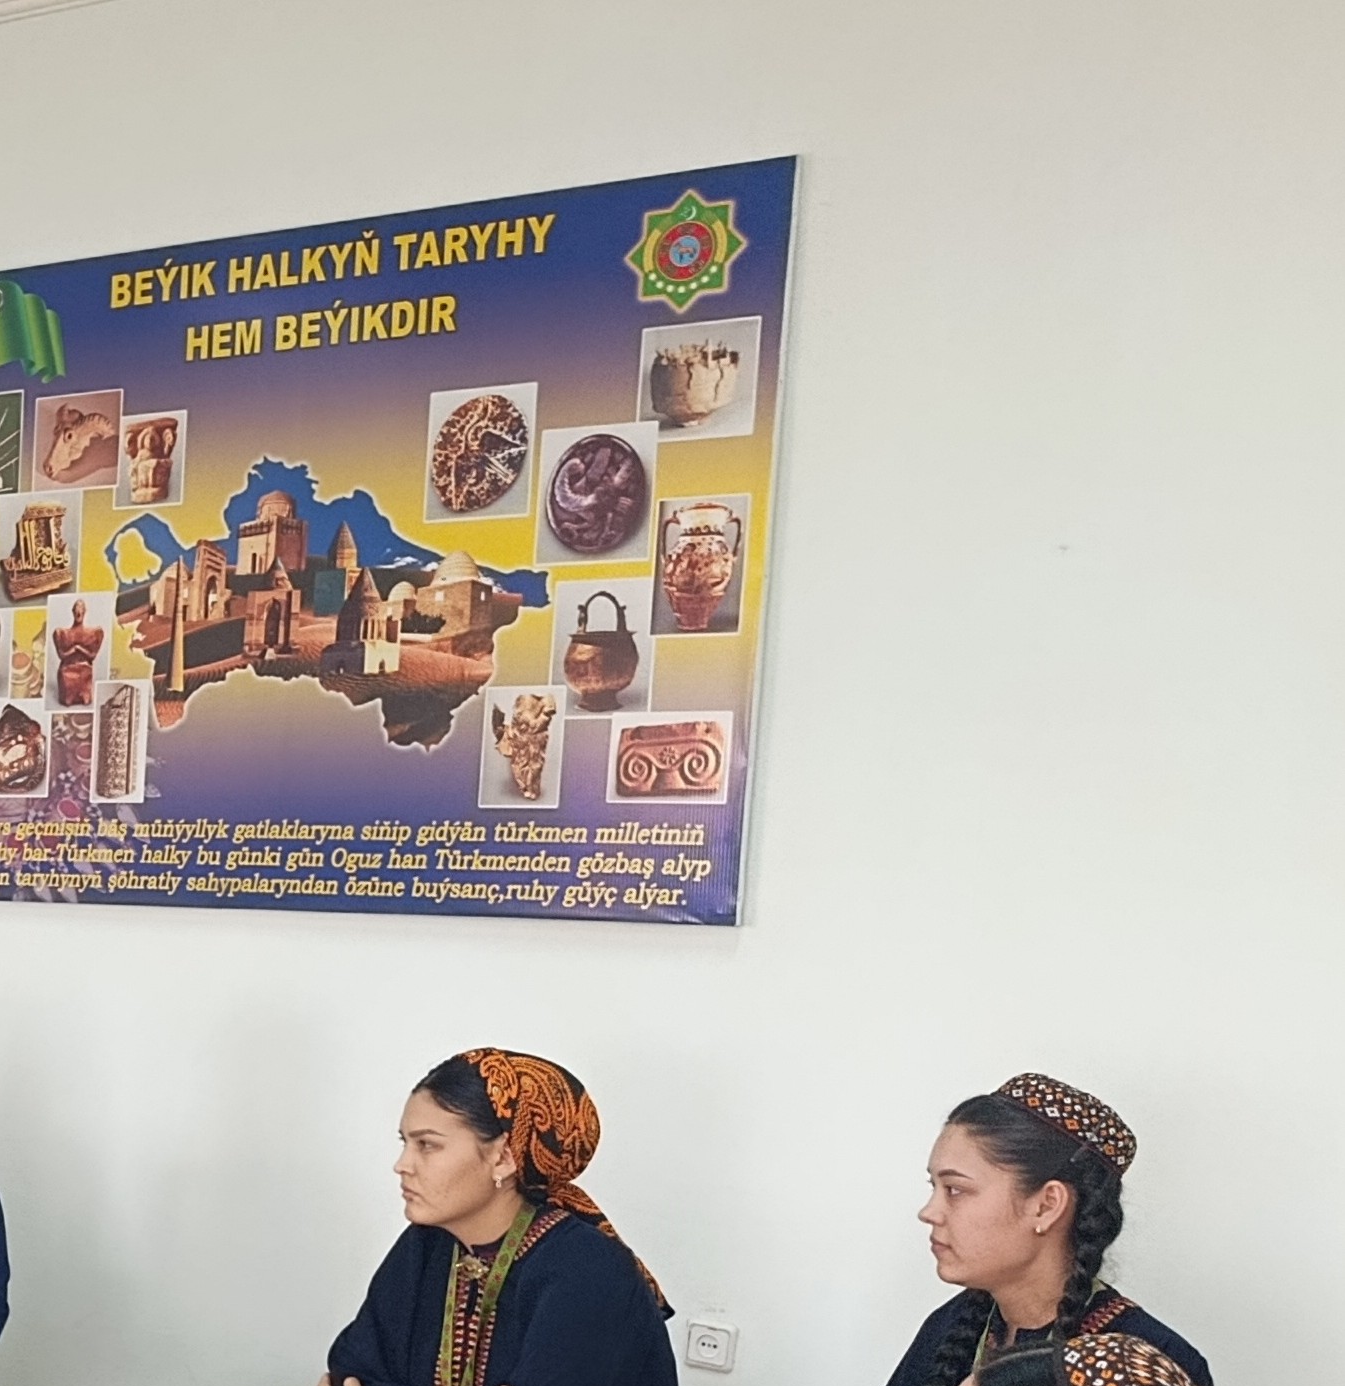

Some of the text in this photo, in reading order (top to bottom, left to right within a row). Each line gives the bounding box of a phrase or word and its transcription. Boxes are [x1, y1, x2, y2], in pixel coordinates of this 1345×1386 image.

[110, 213, 556, 309] BEÝIK HALKYŇ TARYHY
[185, 295, 457, 362] HEM BEÝIKDIR
[232, 818, 355, 845] gatlaklaryna
[360, 820, 411, 846] siňip
[415, 820, 486, 847] gidýän
[494, 821, 588, 843] türkmen
[594, 822, 705, 846] milletiniň
[140, 844, 192, 869] halky
[196, 845, 221, 865] bu
[224, 846, 283, 870] günki
[285, 847, 324, 872] gün
[330, 847, 383, 873] Oguz
[387, 848, 428, 870] han
[435, 848, 571, 872] Türkmenden
[576, 852, 655, 879] gözbaş
[661, 853, 711, 882] alyp
[14, 868, 103, 893] taryhynyň
[107, 870, 183, 895] şöhratly
[186, 872, 339, 898] sahypalaryndan
[344, 876, 406, 896] özüne
[562, 881, 618, 908] güýç
[623, 882, 687, 909] alýar.
